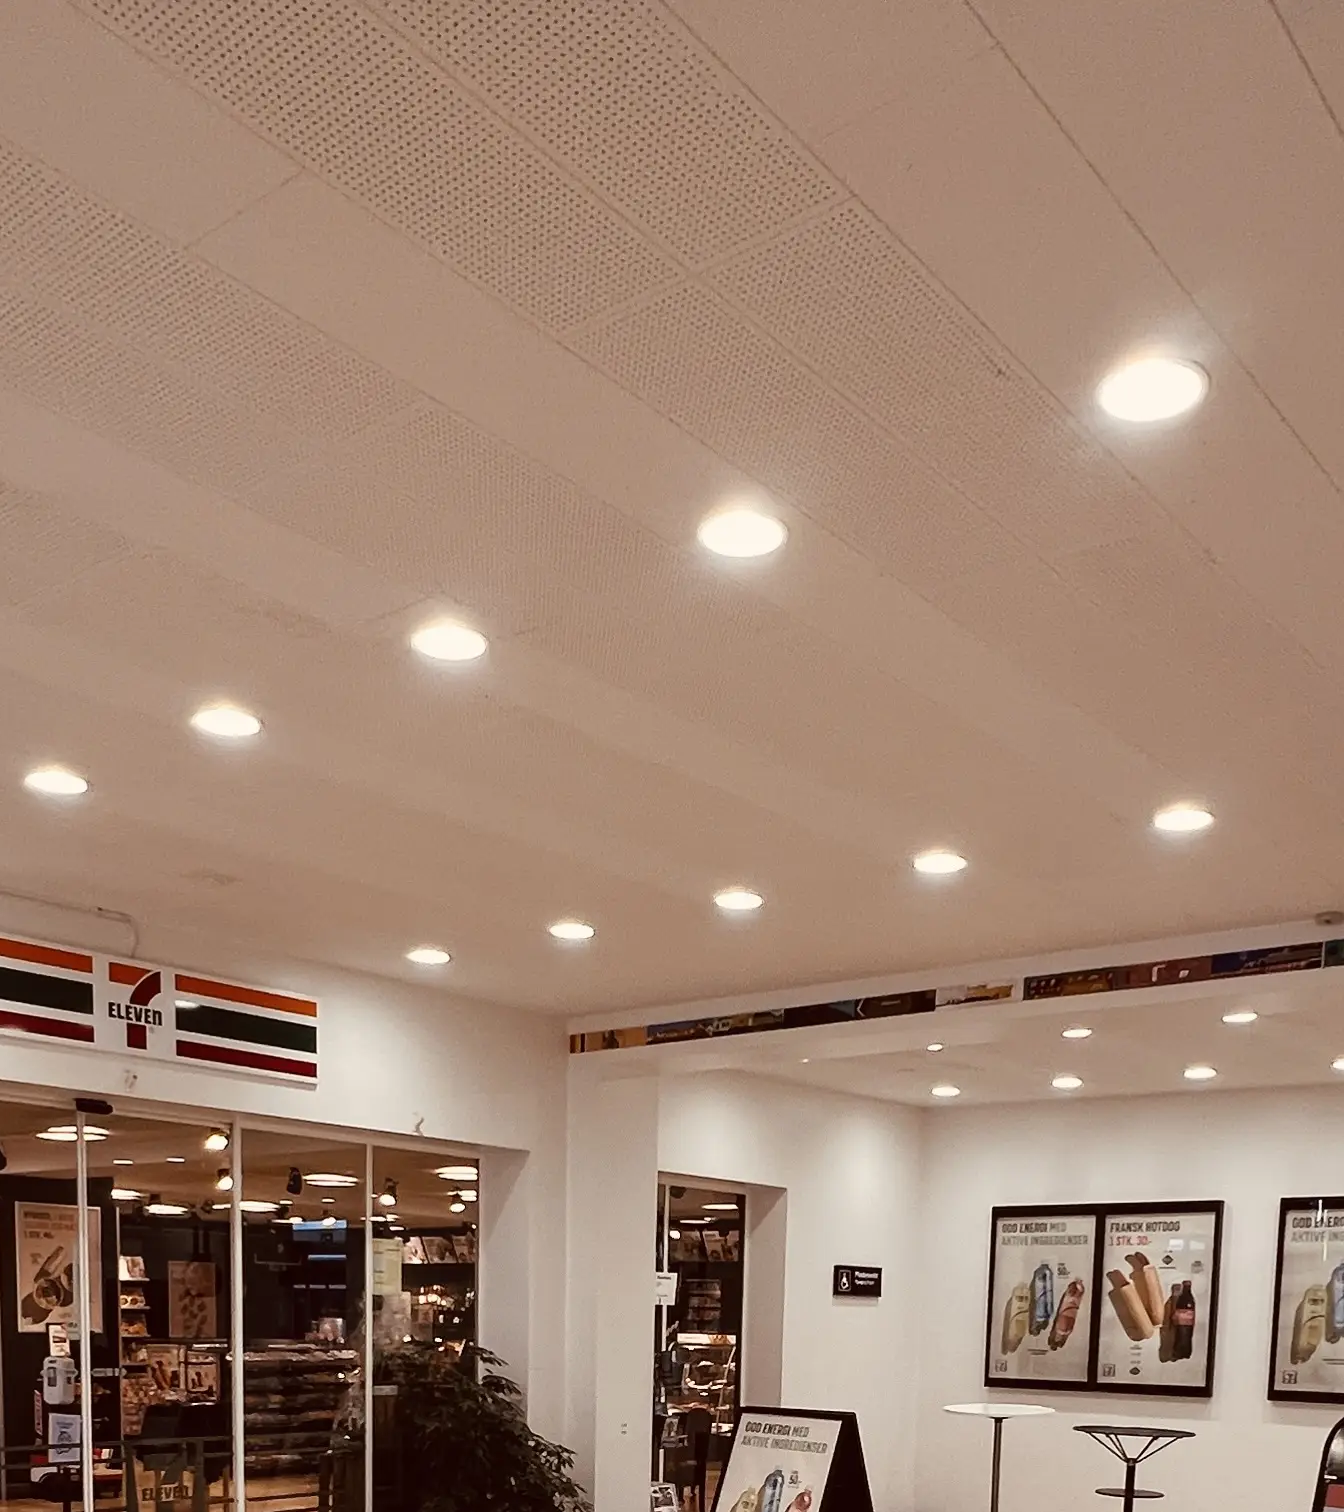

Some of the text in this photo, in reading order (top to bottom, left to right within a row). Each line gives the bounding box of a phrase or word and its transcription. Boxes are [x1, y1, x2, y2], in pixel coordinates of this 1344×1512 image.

[126, 971, 162, 1050] 7
[1110, 1221, 1180, 1233] FRANSK HOTDOG
